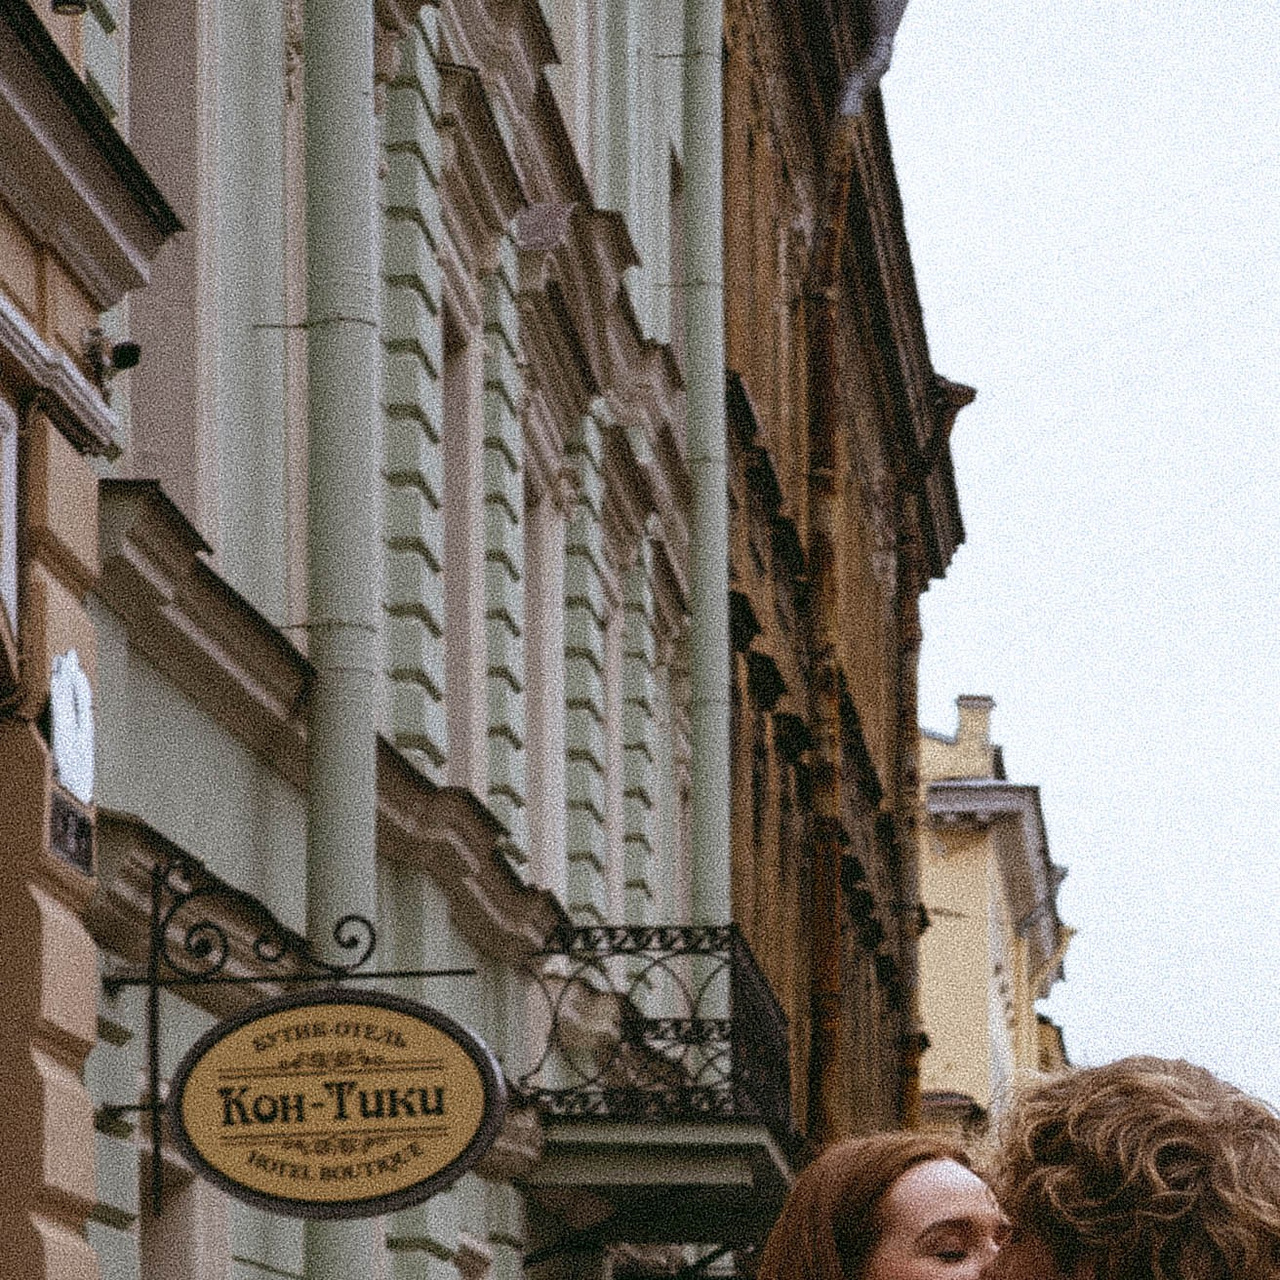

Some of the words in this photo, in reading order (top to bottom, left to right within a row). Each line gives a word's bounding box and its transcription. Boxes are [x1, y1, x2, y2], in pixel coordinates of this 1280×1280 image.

[218, 1081, 444, 1126] Кон-Тики
[246, 1150, 312, 1180] HOTEL
[319, 1142, 424, 1181] BOUTIQUE
